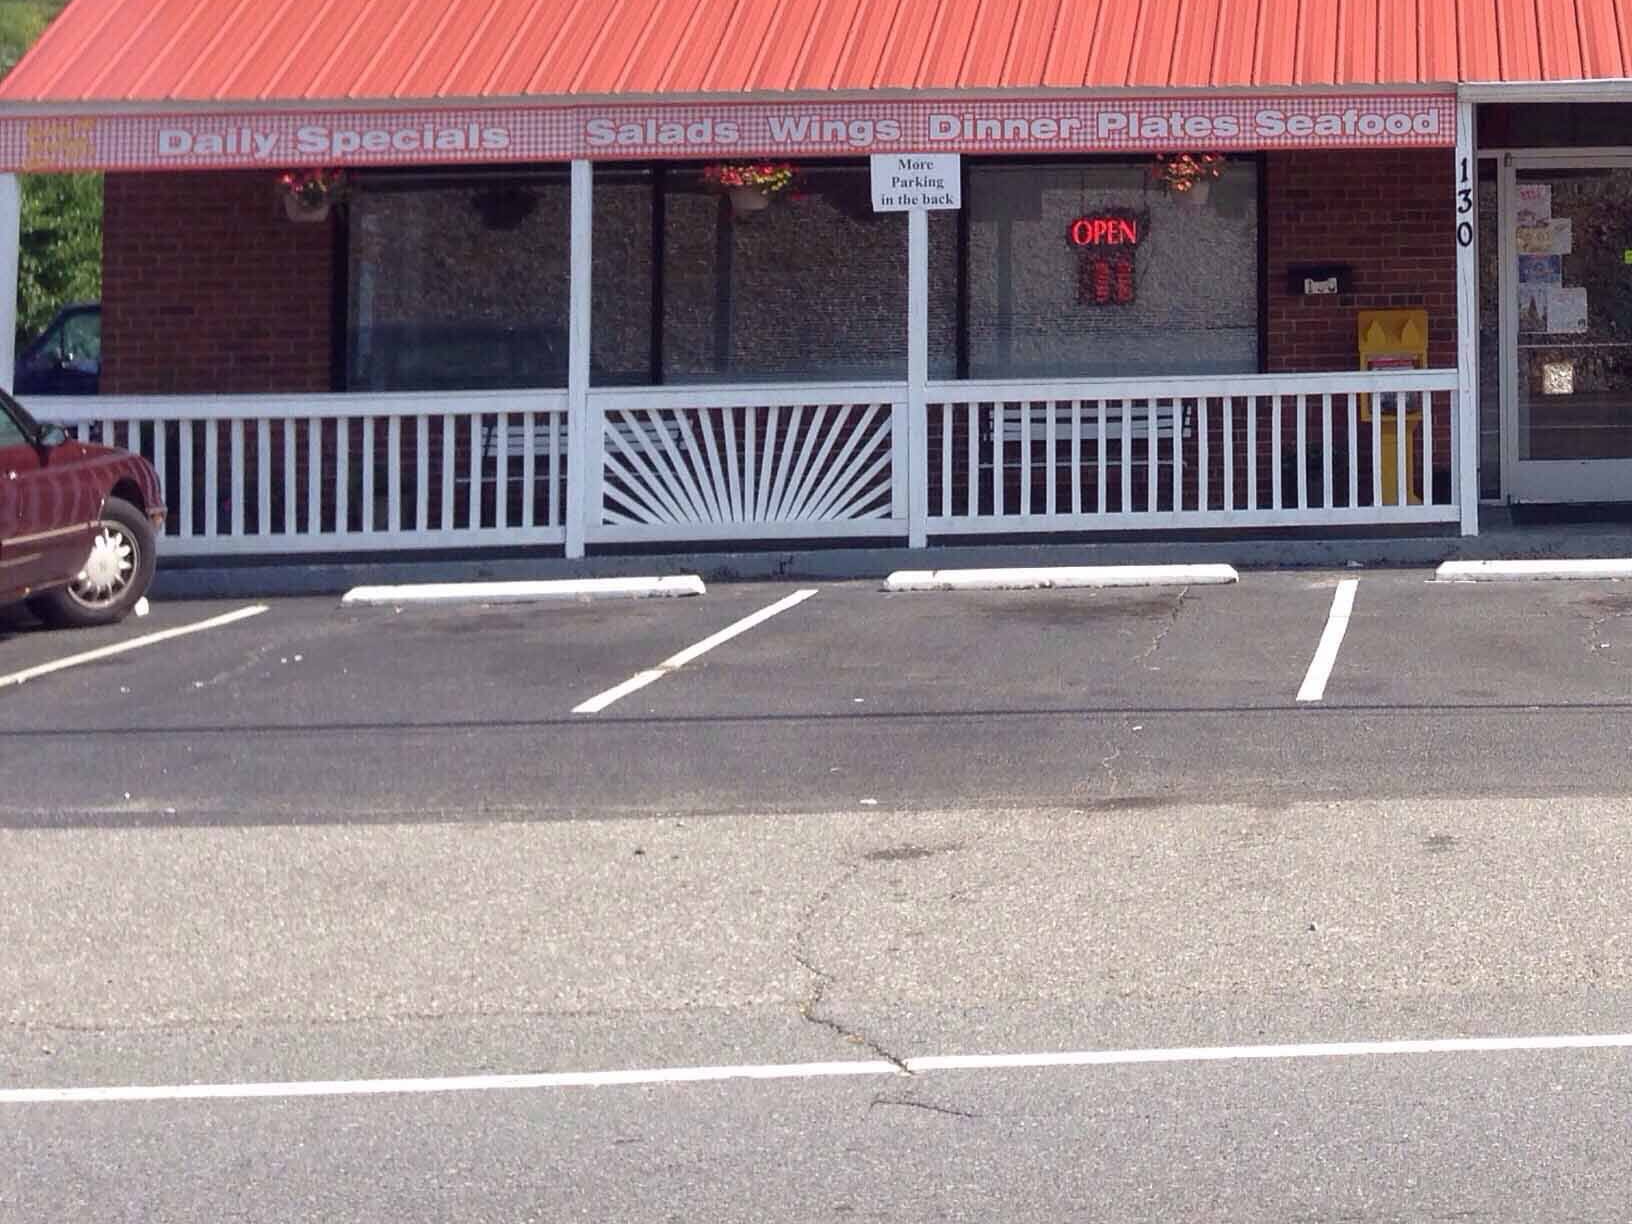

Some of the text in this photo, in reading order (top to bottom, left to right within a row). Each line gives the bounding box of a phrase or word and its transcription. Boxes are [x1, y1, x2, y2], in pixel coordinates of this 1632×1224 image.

[157, 108, 1440, 156] Daily Specials Salads Wings Dinner Plates Seafood
[898, 158, 934, 170] More
[891, 176, 944, 189] Parking
[881, 193, 954, 206] in the back
[1457, 158, 1473, 247] 130
[1072, 219, 1137, 246] OPEN
